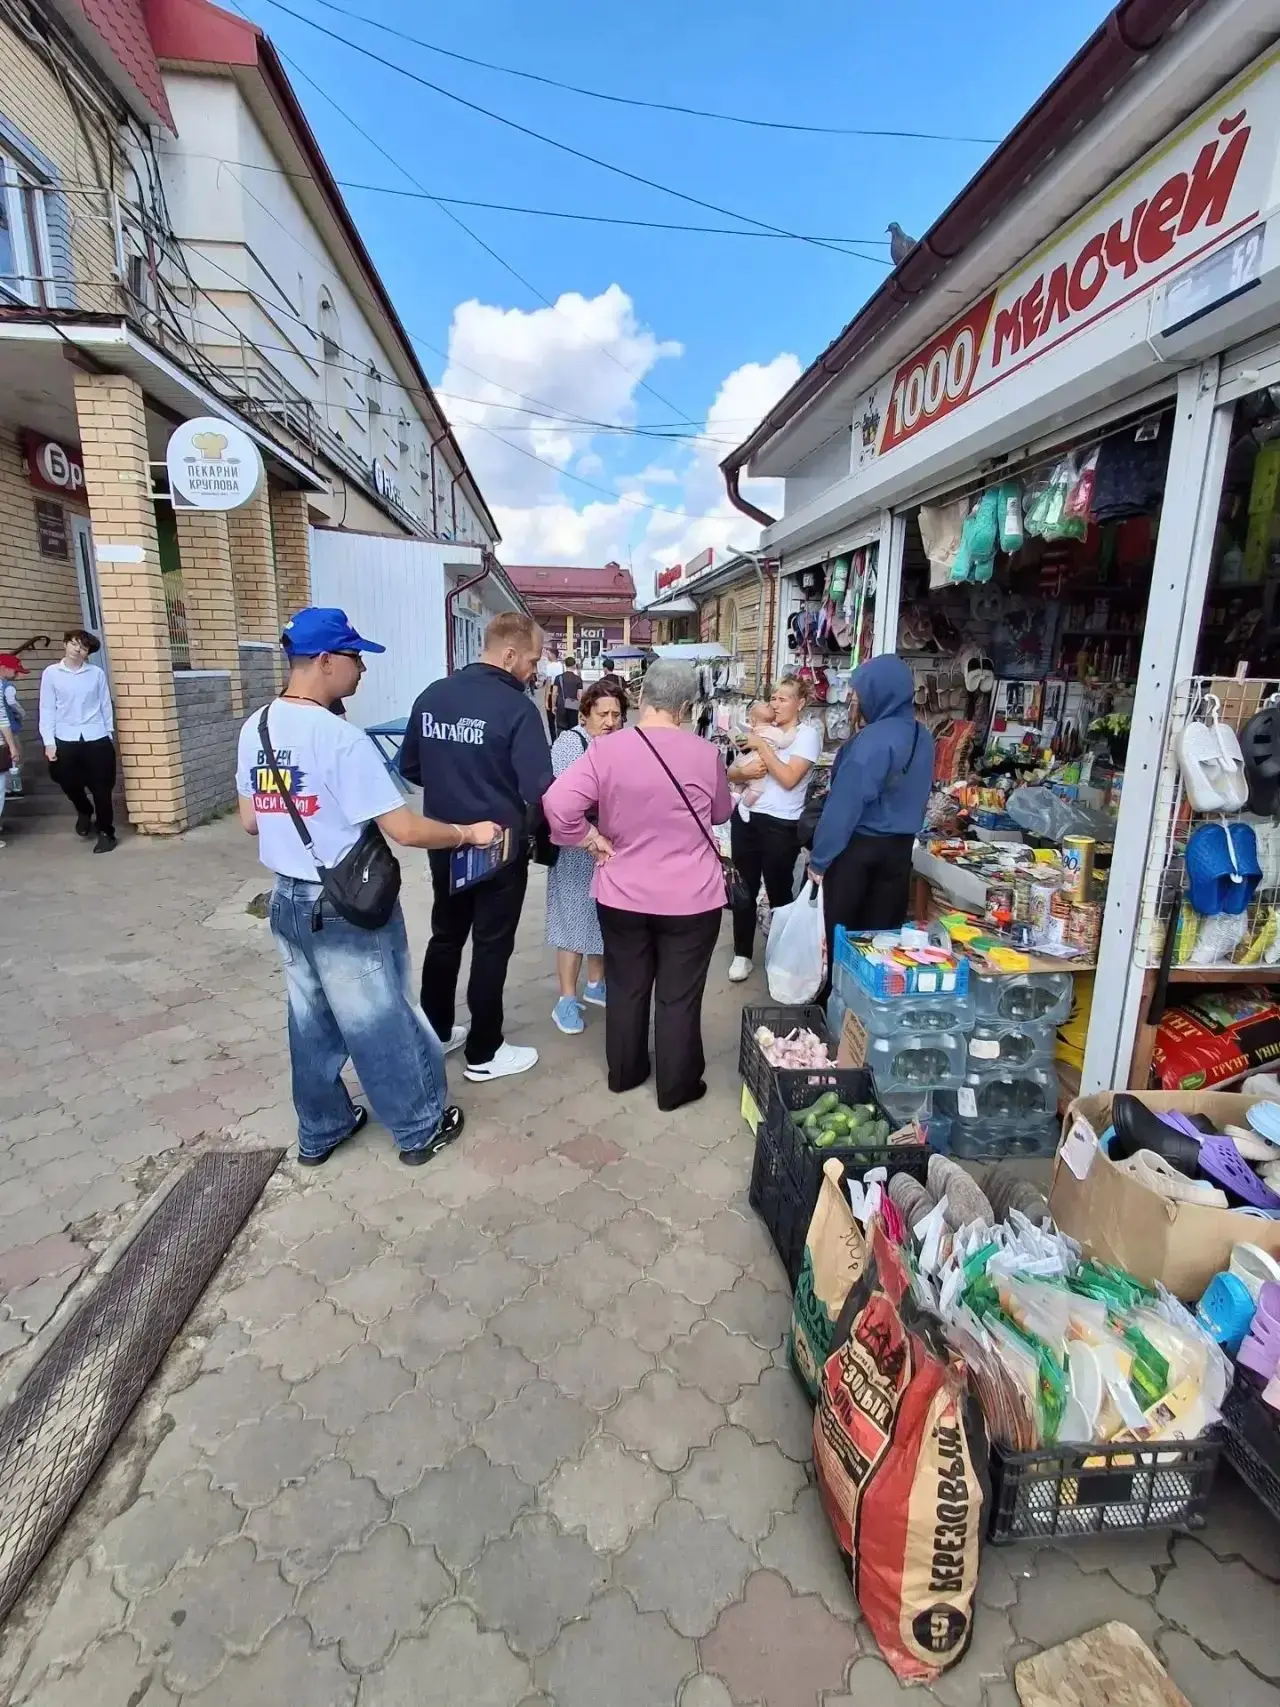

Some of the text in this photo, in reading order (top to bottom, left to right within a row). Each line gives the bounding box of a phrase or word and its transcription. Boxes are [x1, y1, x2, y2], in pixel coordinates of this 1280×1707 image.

[892, 327, 974, 437] 1000
[187, 465, 239, 478] ПЕКАРНИ
[189, 479, 240, 491] КРУГЛОВА
[581, 627, 605, 638] kari
[1211, 1053, 1250, 1077] ГРУНТ
[929, 1422, 968, 1592] БЕРЕЗОВЫЙ
[931, 1612, 950, 1637] 5
